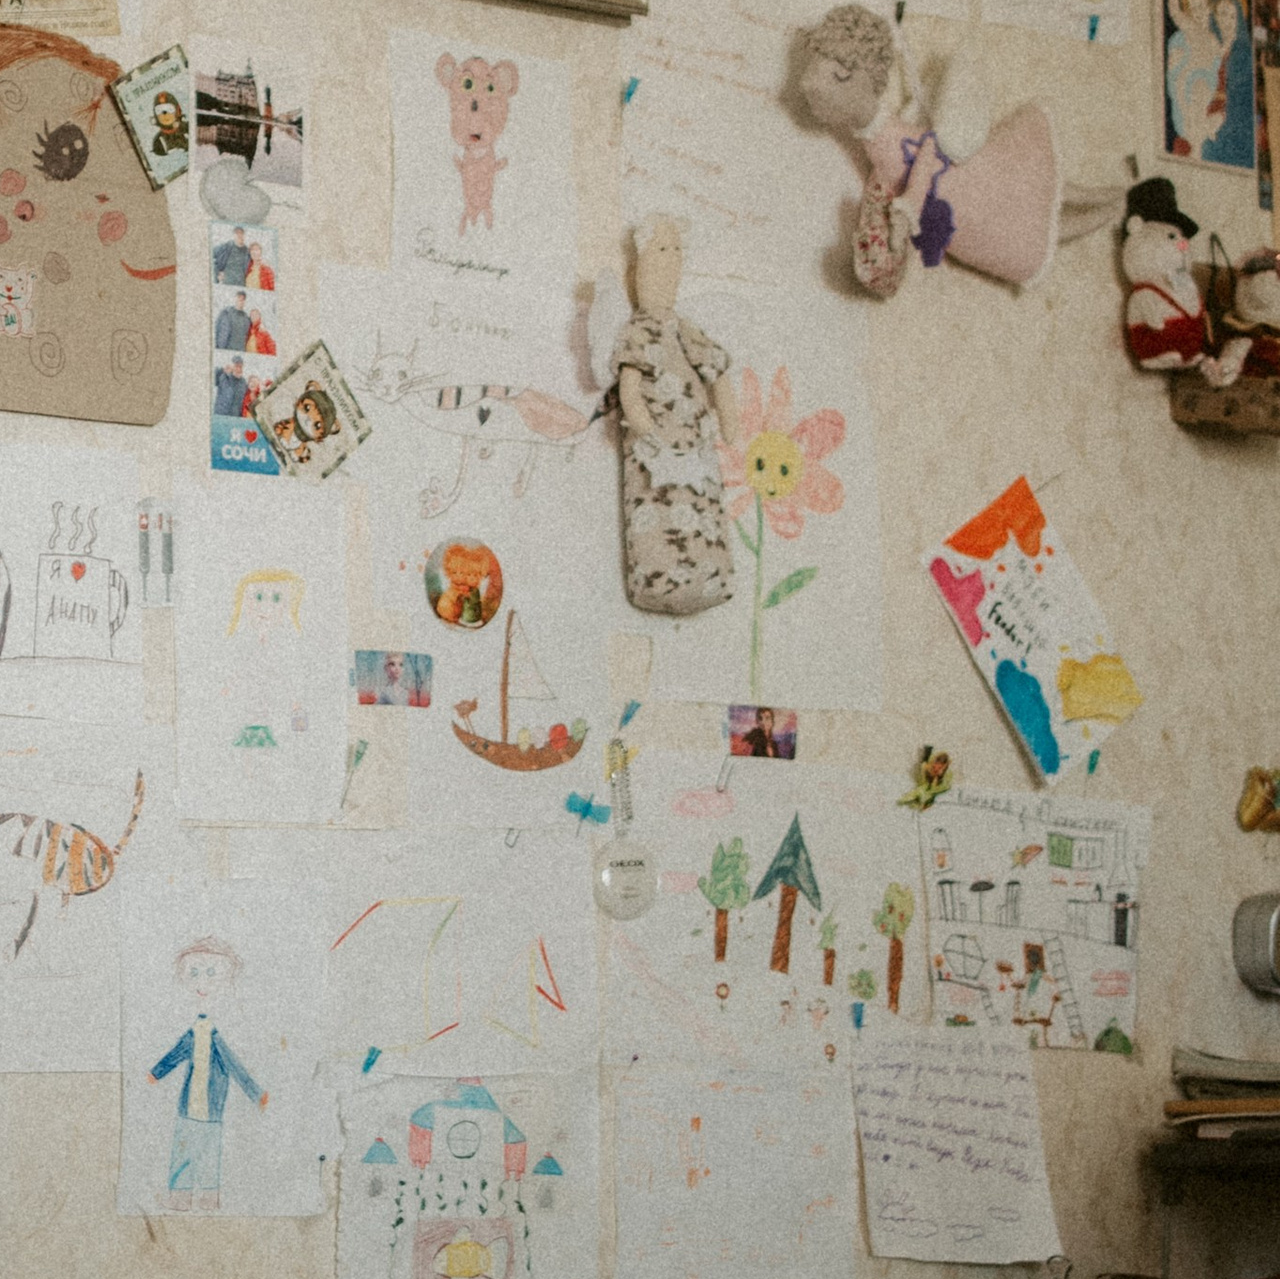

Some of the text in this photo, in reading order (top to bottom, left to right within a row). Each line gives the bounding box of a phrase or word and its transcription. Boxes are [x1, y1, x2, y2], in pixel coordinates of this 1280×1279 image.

[229, 427, 242, 443] Я
[220, 443, 268, 463] СОЧИ
[49, 558, 62, 581] Я
[44, 594, 99, 628] АНАПУ
